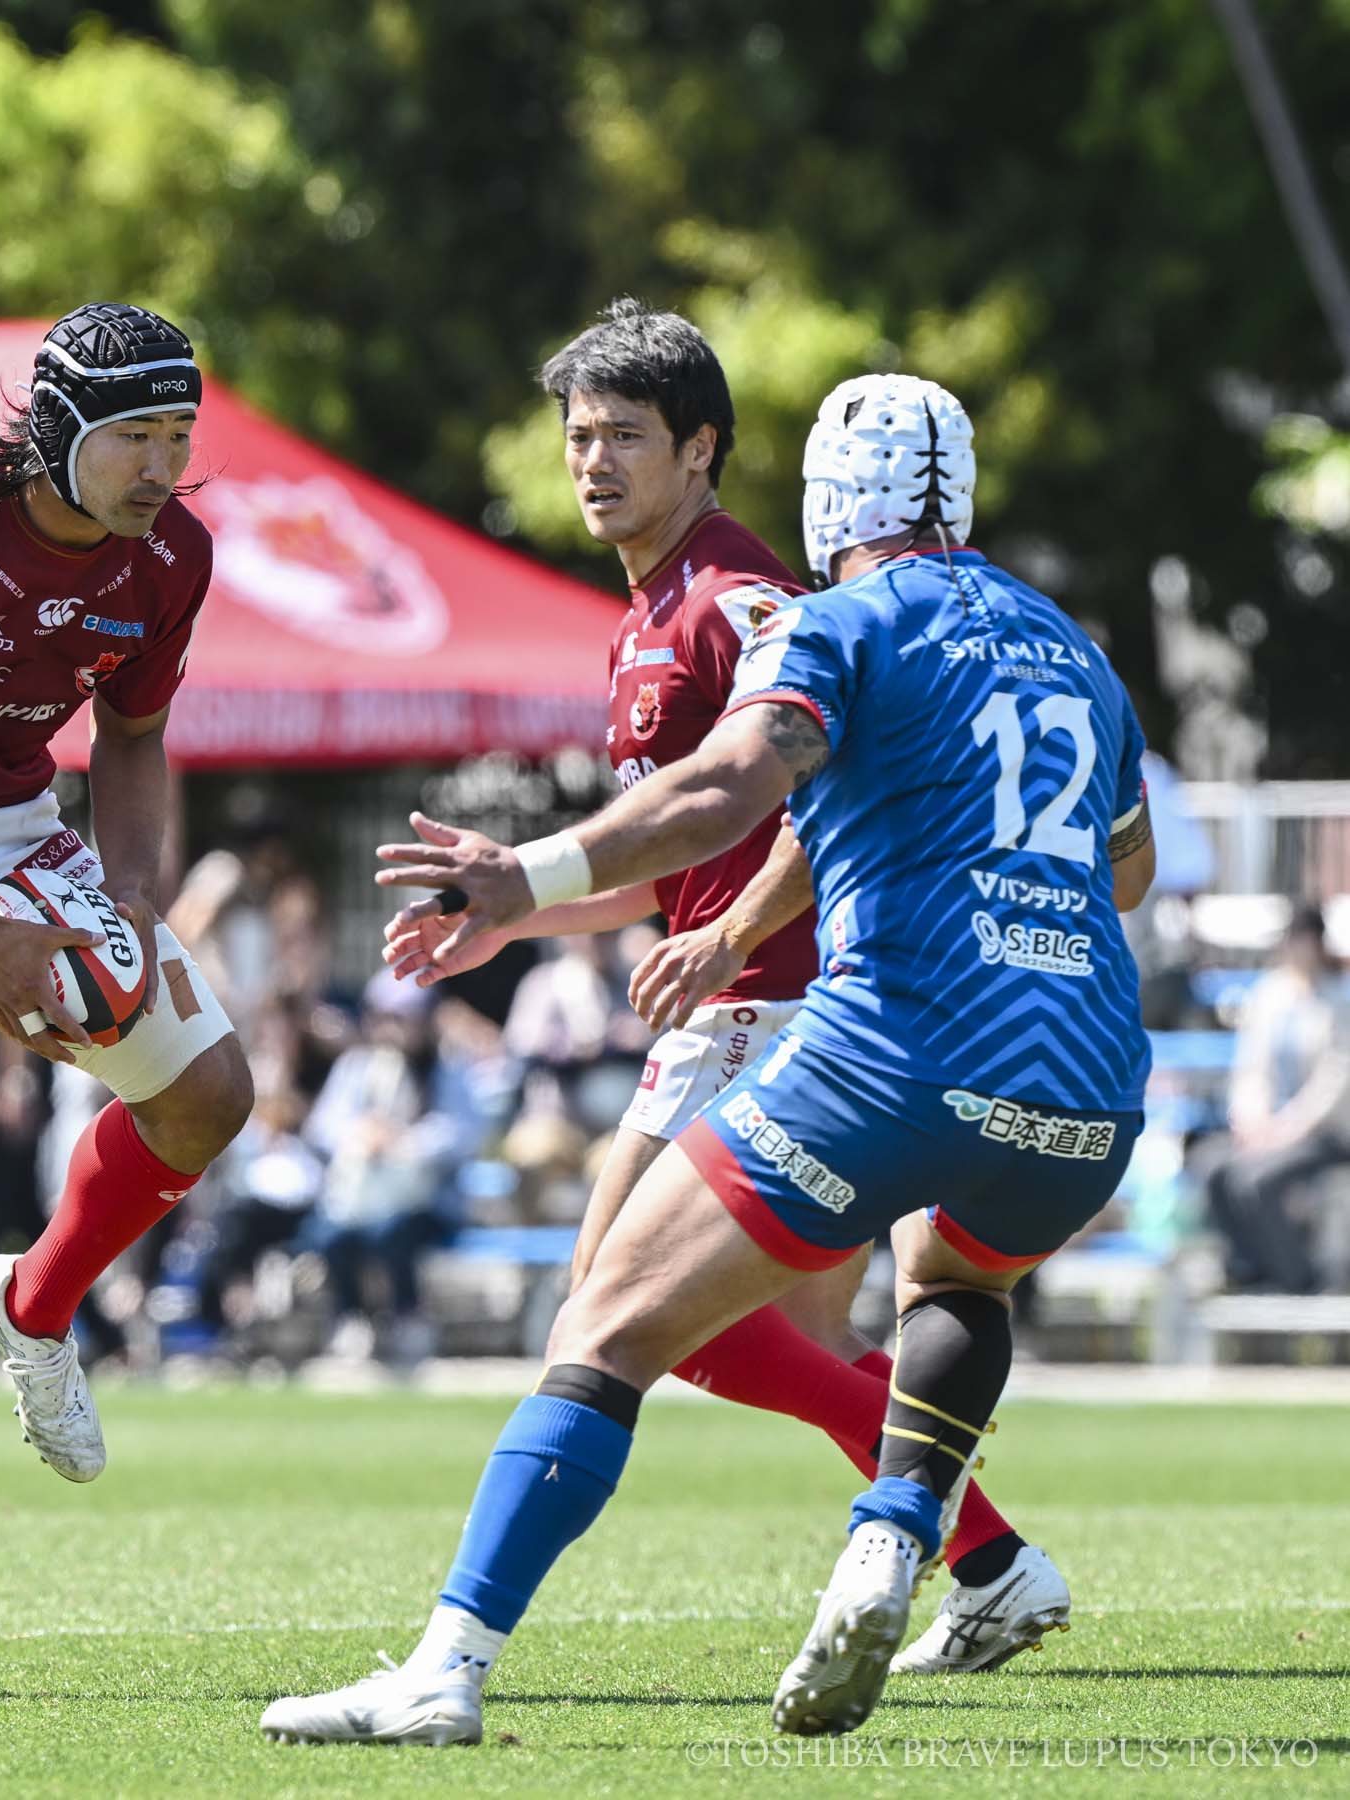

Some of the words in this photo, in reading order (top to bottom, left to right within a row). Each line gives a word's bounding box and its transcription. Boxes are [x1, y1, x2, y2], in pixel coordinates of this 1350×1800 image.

[940, 639, 1090, 669] SHIMIZU
[970, 690, 1098, 871] 12
[984, 1102, 1114, 1158] 日本道路
[755, 1124, 851, 1212] 日本建設
